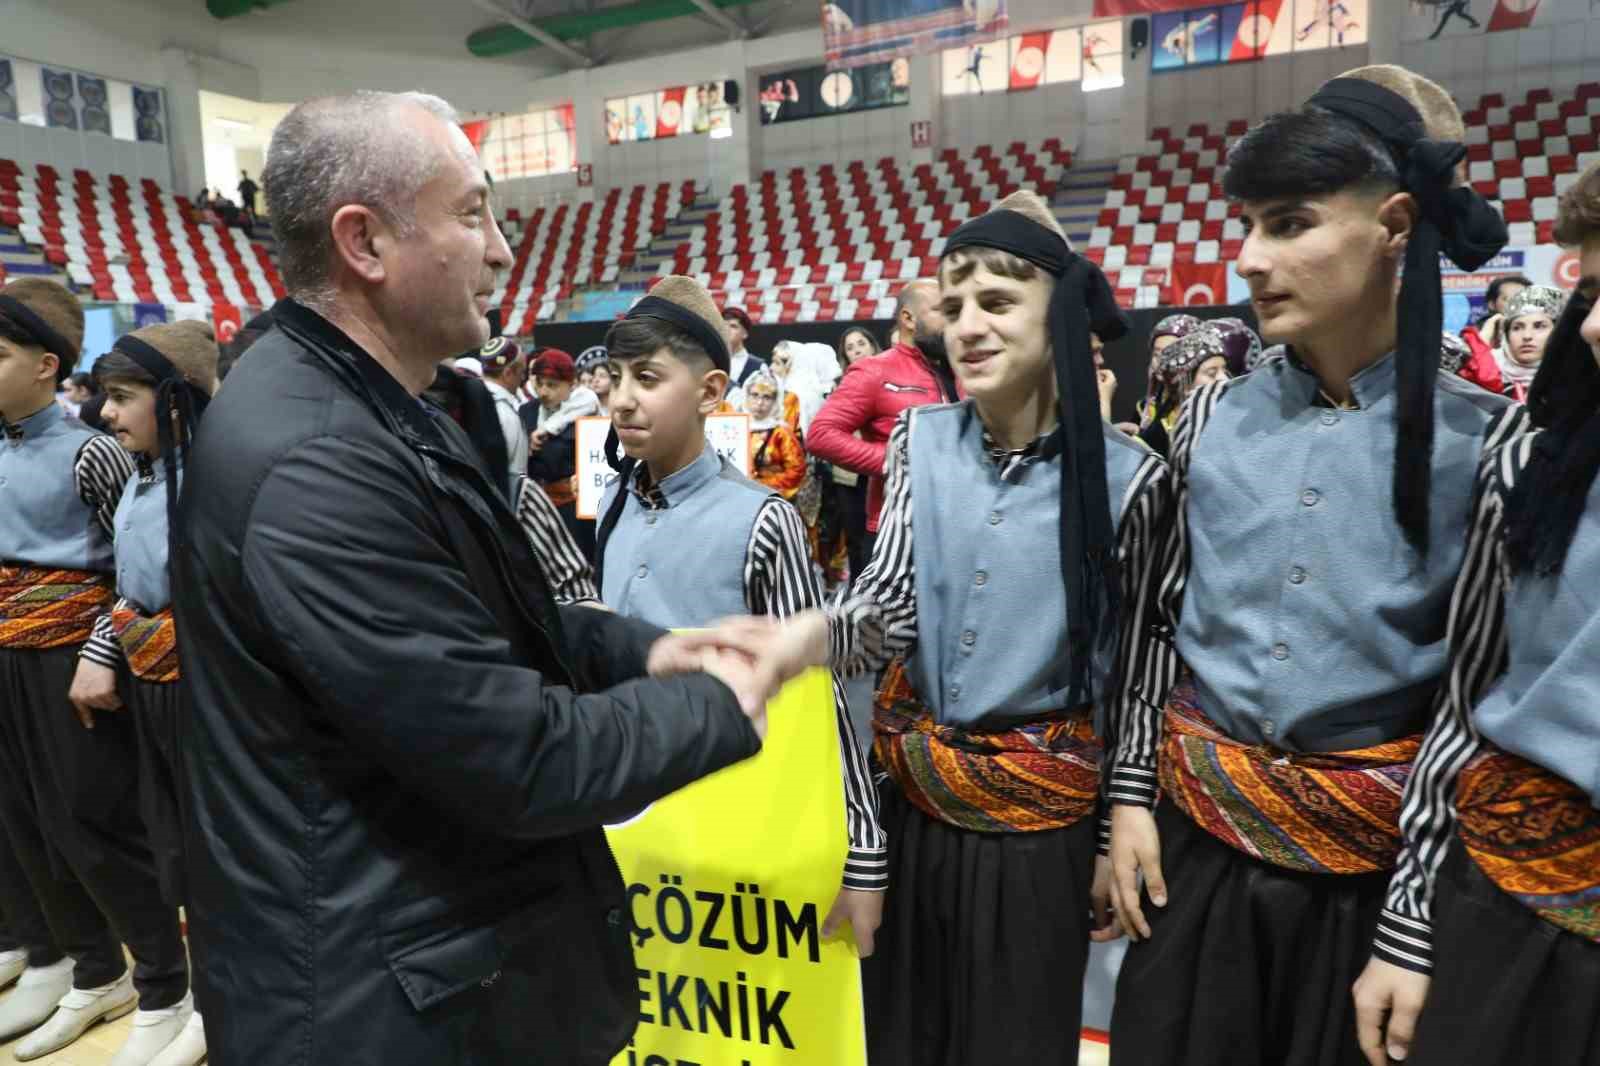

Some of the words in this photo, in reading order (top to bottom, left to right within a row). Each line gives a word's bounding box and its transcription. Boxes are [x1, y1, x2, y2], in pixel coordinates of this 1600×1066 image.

[914, 123, 927, 141] H
[627, 874, 820, 963] ÇÖZÜM
[636, 967, 796, 1050] EKNİK
